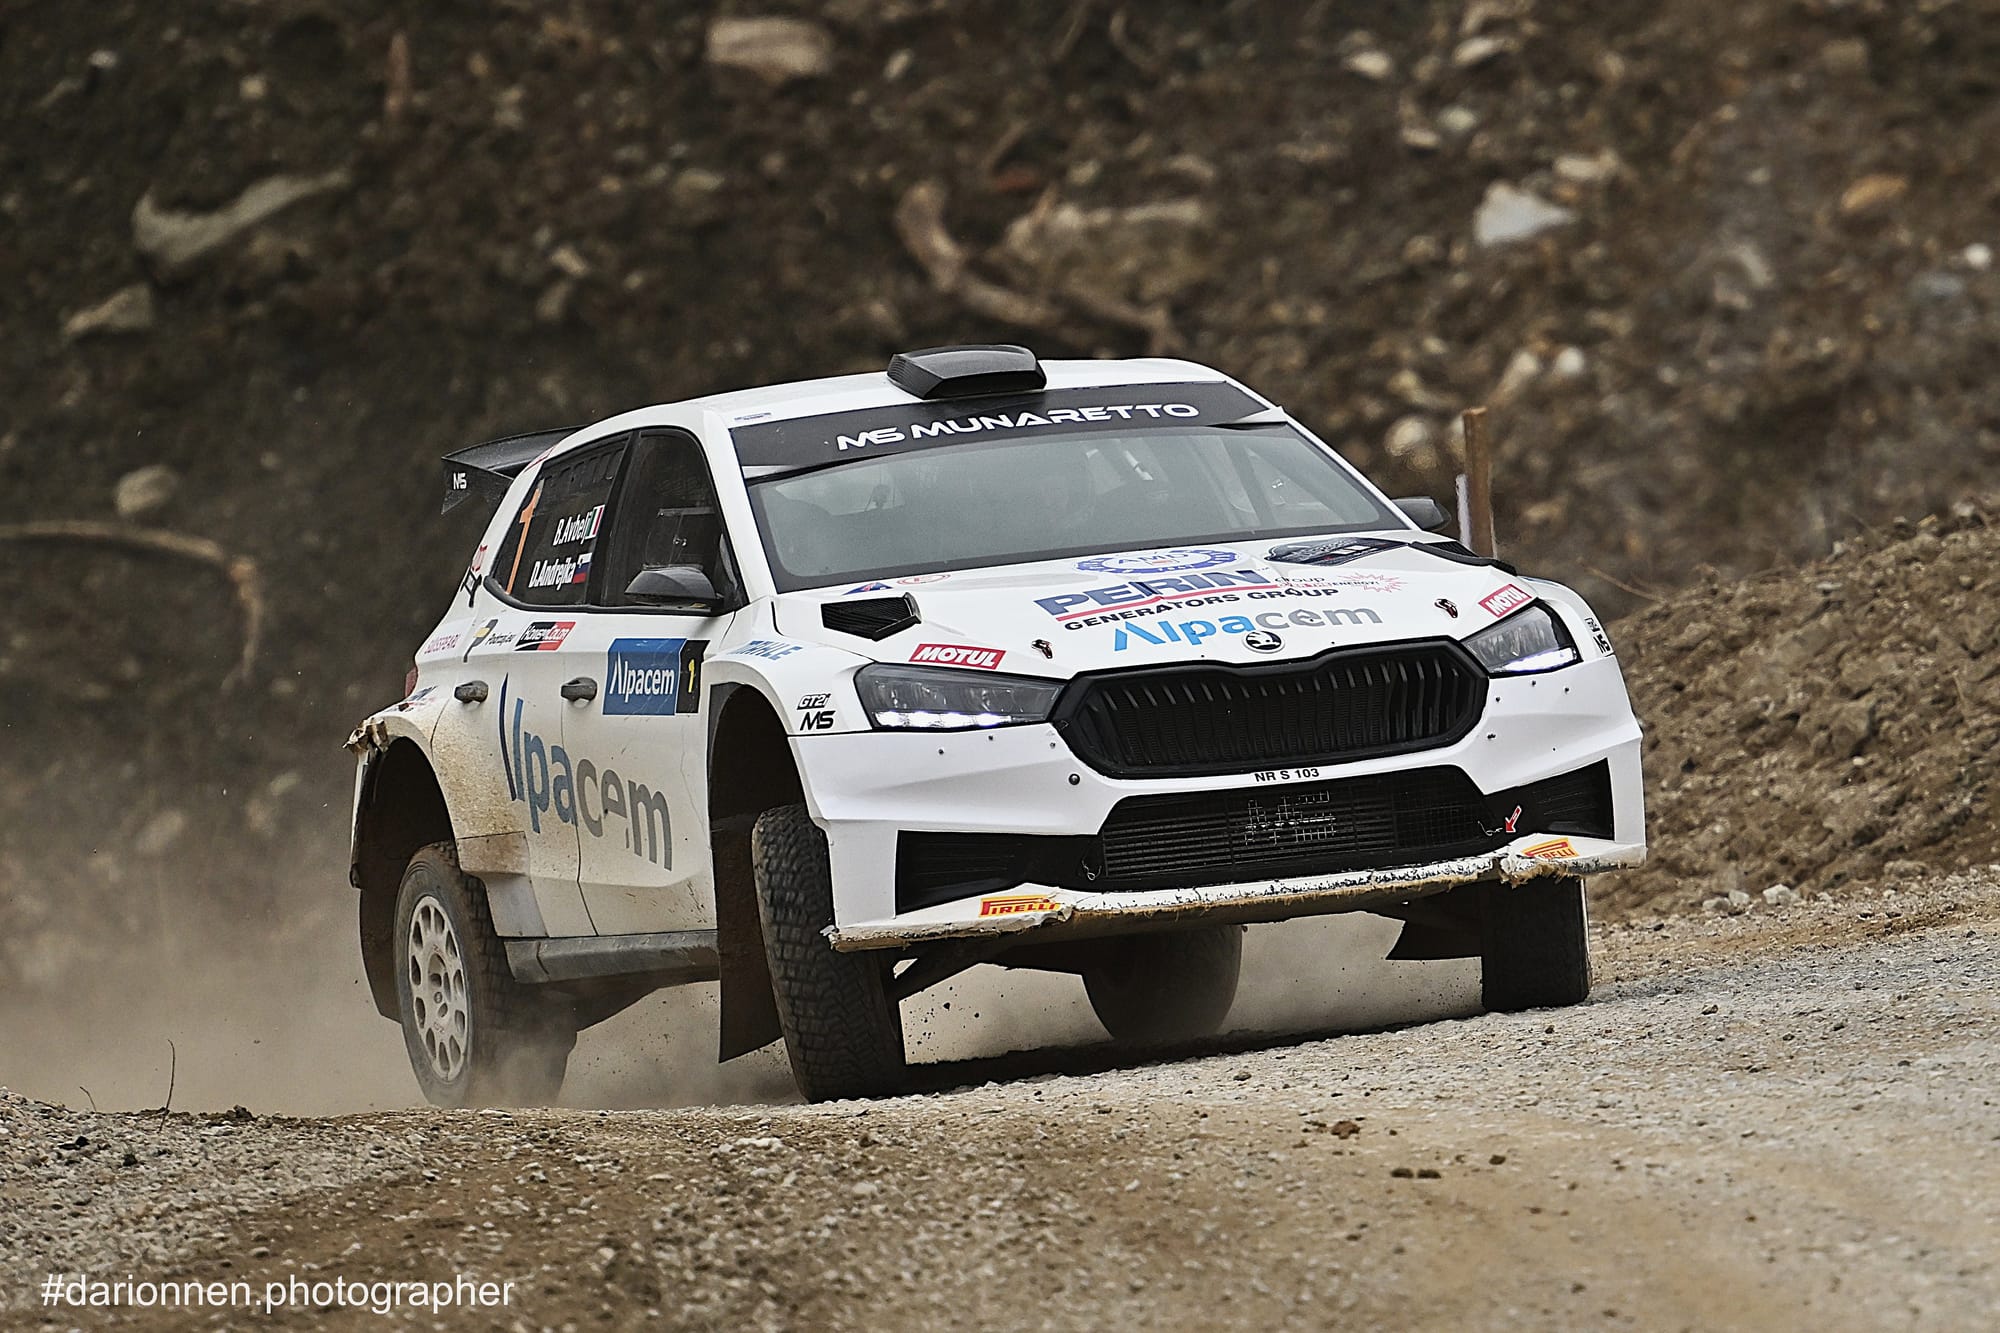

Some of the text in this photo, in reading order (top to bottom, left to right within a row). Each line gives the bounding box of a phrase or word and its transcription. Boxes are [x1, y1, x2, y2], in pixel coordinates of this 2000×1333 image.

[836, 403, 1201, 451] MS MUNARETTO
[505, 479, 544, 595] 1
[1032, 570, 1271, 616] PERIN
[1065, 588, 1339, 630] GENERATORS GROUP
[1485, 586, 1529, 615] MOTUL
[1115, 606, 1383, 651] Alpacem
[687, 658, 695, 693] 1
[915, 646, 998, 667] MOTUL
[608, 651, 675, 703] Alpacem
[799, 710, 836, 731] MS
[1254, 768, 1319, 782] NR S 103
[980, 897, 1057, 916] PIRELLI
